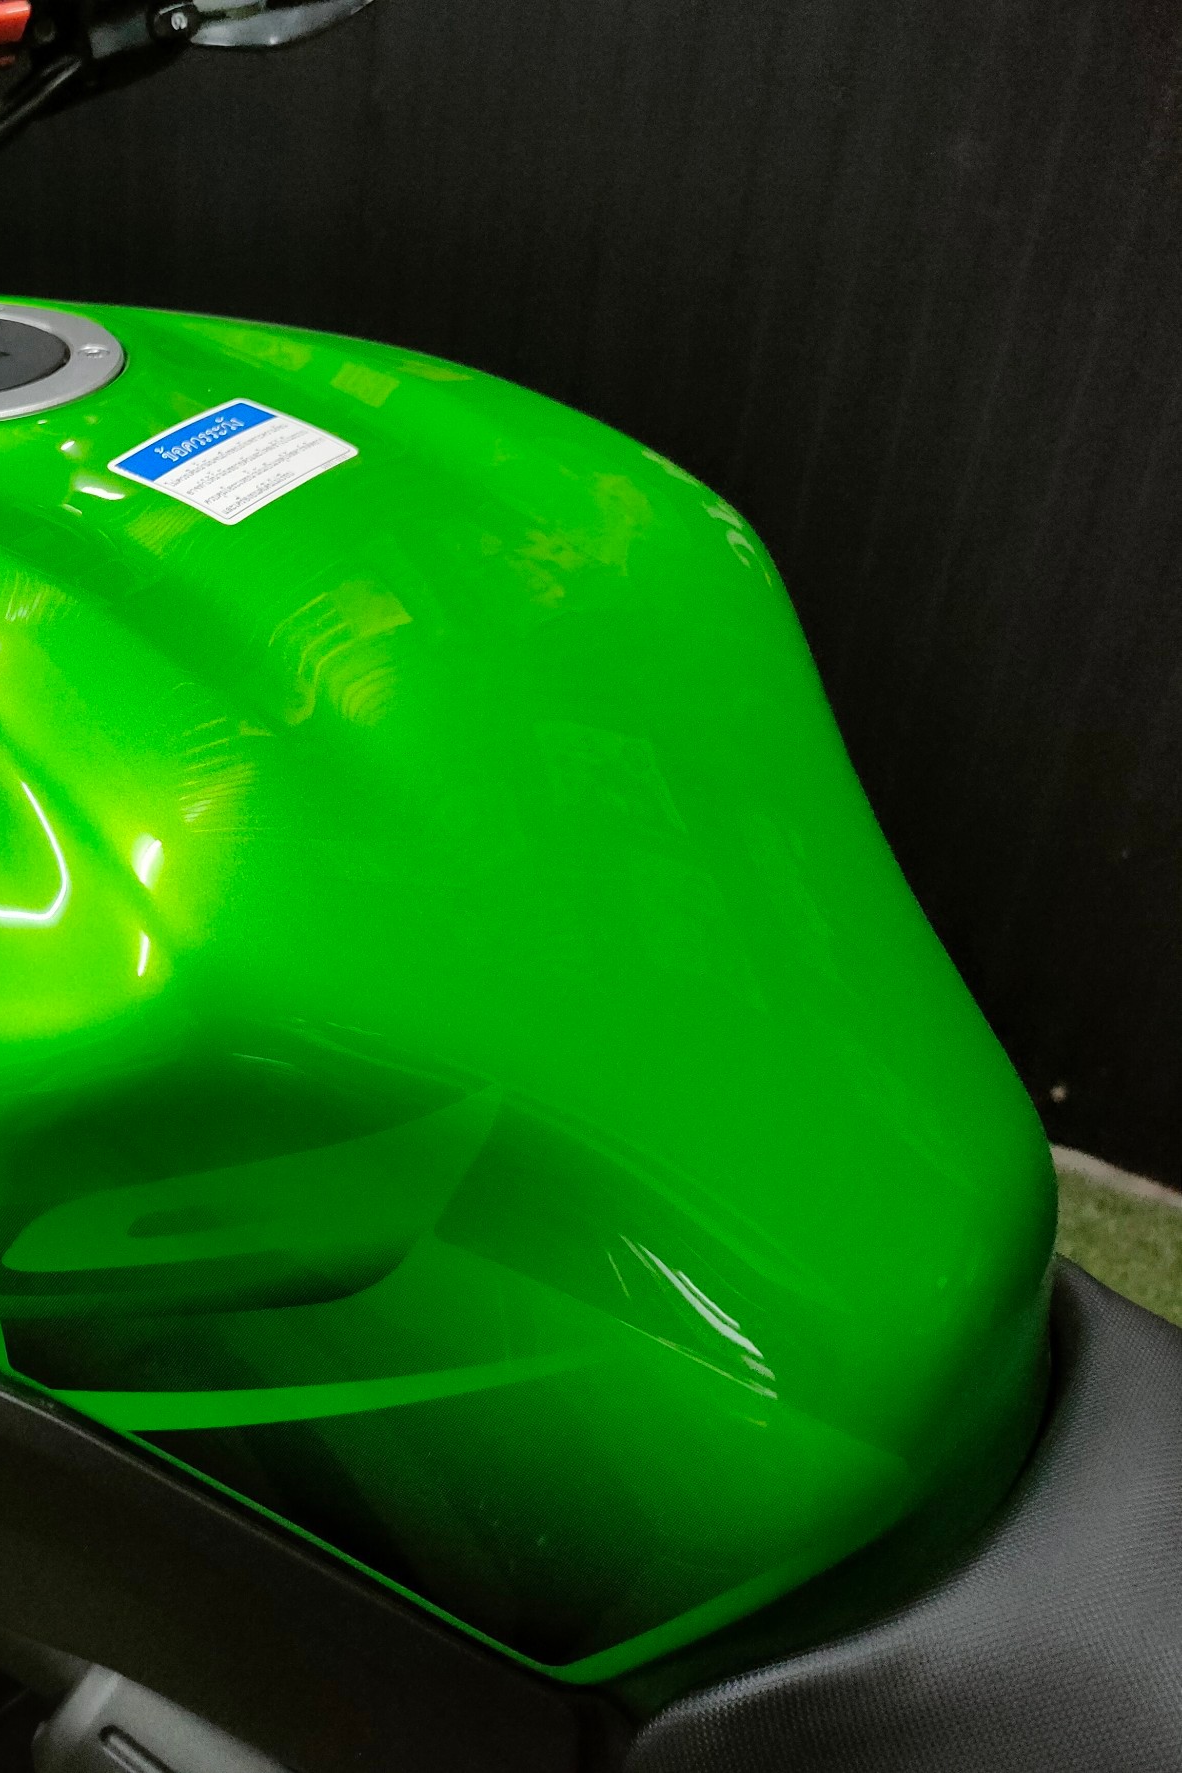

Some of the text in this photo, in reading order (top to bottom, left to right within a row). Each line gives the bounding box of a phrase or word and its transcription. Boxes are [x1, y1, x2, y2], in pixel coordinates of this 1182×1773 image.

[154, 416, 245, 463] ข้อควรระวัง
